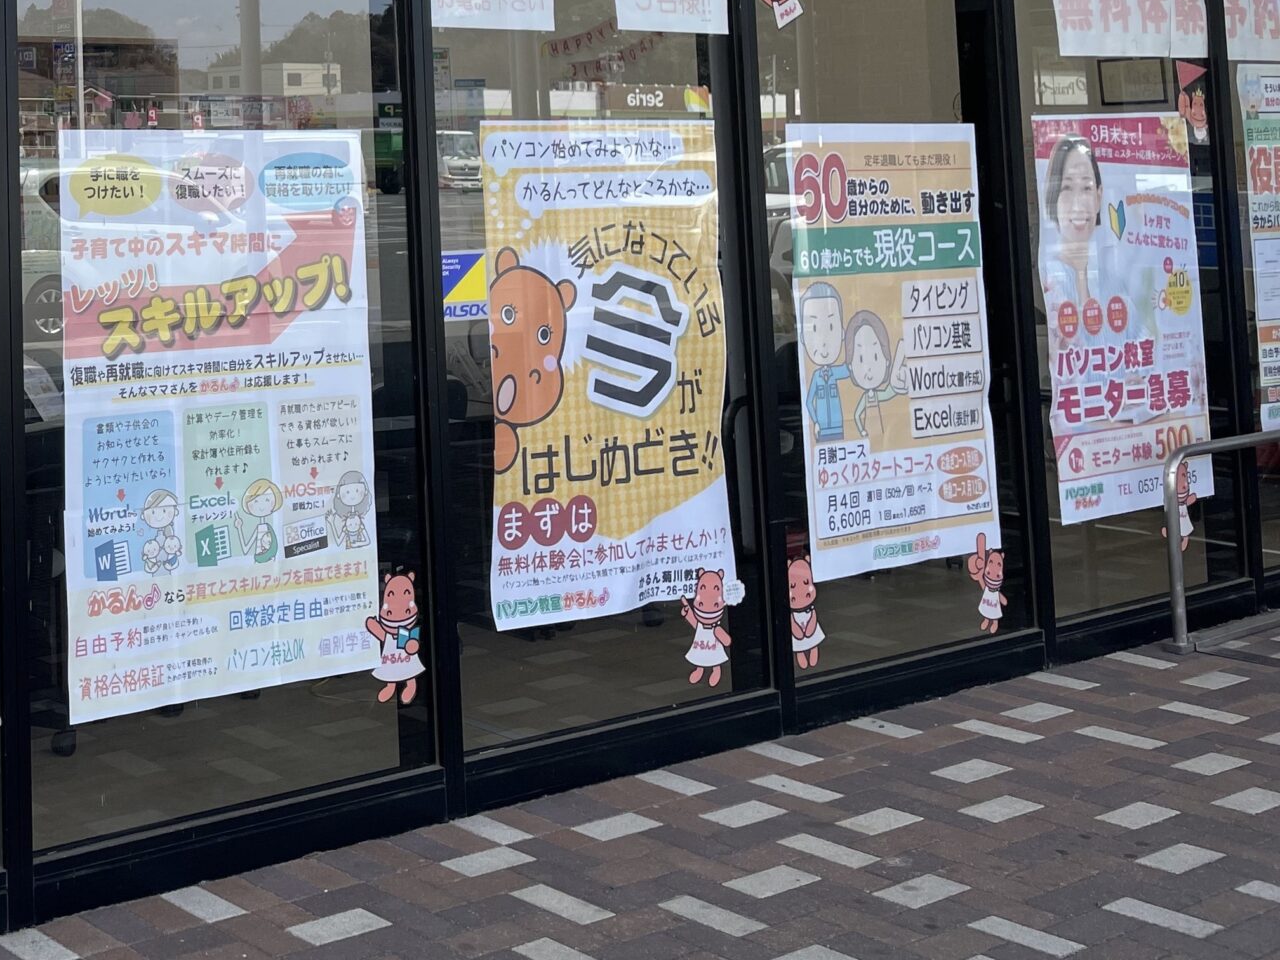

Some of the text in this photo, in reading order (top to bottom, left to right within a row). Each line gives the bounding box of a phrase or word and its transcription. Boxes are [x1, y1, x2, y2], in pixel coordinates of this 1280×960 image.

[89, 165, 141, 182] 手に職を
[181, 166, 241, 181] スムーズに
[793, 151, 848, 224] 60
[920, 189, 975, 215] 動き出す
[70, 231, 283, 261] 子育て中のスキマ時間に
[910, 280, 970, 313] タイピング
[444, 303, 488, 318] ALSOK
[912, 320, 972, 352] パソコン基礎
[1056, 338, 1155, 378] パソコン教室
[1056, 369, 1192, 425] モニター急募
[96, 434, 160, 452] お知らせなどを
[817, 443, 867, 466] 月謝コース
[1091, 441, 1153, 468] モニター体験
[92, 451, 165, 468] サクサクと作れる
[817, 453, 935, 488] ゆっくりスタートコース
[827, 491, 860, 514] 月4回
[1118, 483, 1133, 497] TEL
[300, 526, 325, 540] Office
[503, 502, 593, 542] まずは
[828, 509, 871, 532] 6,600円
[229, 597, 324, 632] 回数設定自由
[75, 627, 143, 658] 自由予約
[78, 664, 165, 702] 資格合格保証
